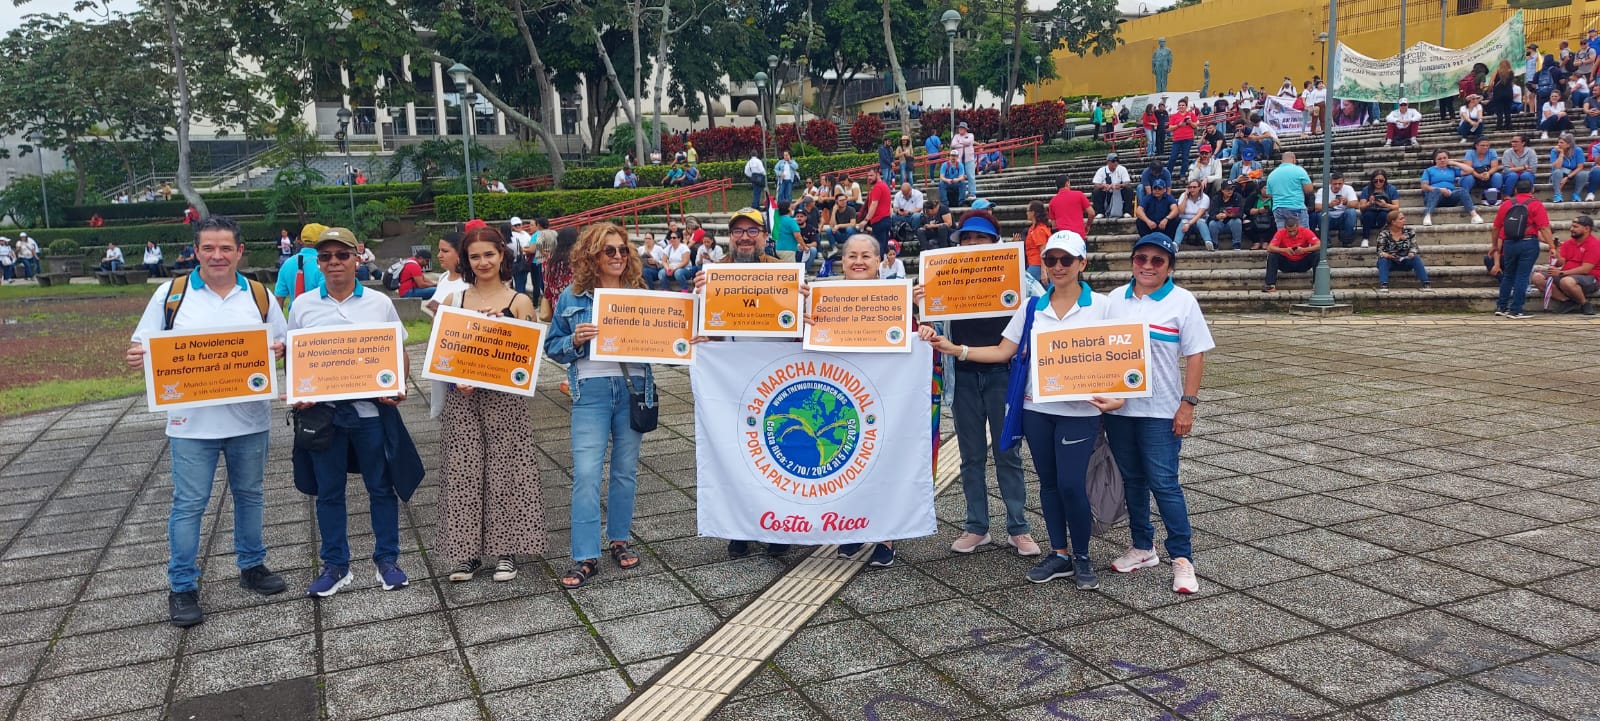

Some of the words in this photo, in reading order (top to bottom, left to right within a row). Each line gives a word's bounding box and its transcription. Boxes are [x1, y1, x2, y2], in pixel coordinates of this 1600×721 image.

[982, 253, 1017, 261] entender
[960, 266, 1004, 275] importante
[708, 272, 773, 283] ¡Democracia
[966, 275, 1006, 286] personas?
[724, 286, 788, 296] participativa
[743, 299, 759, 308] YA!
[638, 307, 665, 316] quiere
[668, 307, 684, 317] Paz,
[603, 317, 640, 326] defiende
[653, 319, 688, 329] Justicia!
[482, 325, 512, 336] sueñas
[190, 338, 244, 348] Noviolencia
[310, 337, 344, 346] violencia
[359, 334, 393, 343] aprende
[475, 336, 503, 345] mundo
[505, 341, 530, 352] mejor,
[1049, 340, 1068, 352] ¡No
[1072, 336, 1105, 348] habrá
[1108, 334, 1132, 345] PAZ
[307, 348, 354, 357] Noviolencia
[357, 345, 390, 354] también
[440, 339, 489, 357] Soñemos
[199, 351, 228, 360] fuerza
[1039, 357, 1054, 366] sin
[1058, 352, 1102, 364] Justicia
[1106, 349, 1144, 361] Social!
[157, 364, 220, 376] transformará
[234, 360, 265, 368] mundo
[756, 361, 816, 398] MARCHA
[820, 362, 874, 412] MUNDIAL
[748, 398, 765, 414] 3a
[767, 421, 775, 445] Costa
[771, 445, 787, 465] Rica:
[812, 465, 832, 476] 2024
[832, 458, 841, 467] al
[847, 418, 856, 440] 2025
[746, 431, 762, 458] POR
[754, 456, 771, 475] LA
[766, 469, 791, 491] PAZ
[792, 482, 800, 495] Y
[802, 484, 817, 497] LA
[760, 511, 812, 533] Costa
[821, 512, 869, 532] Rica
